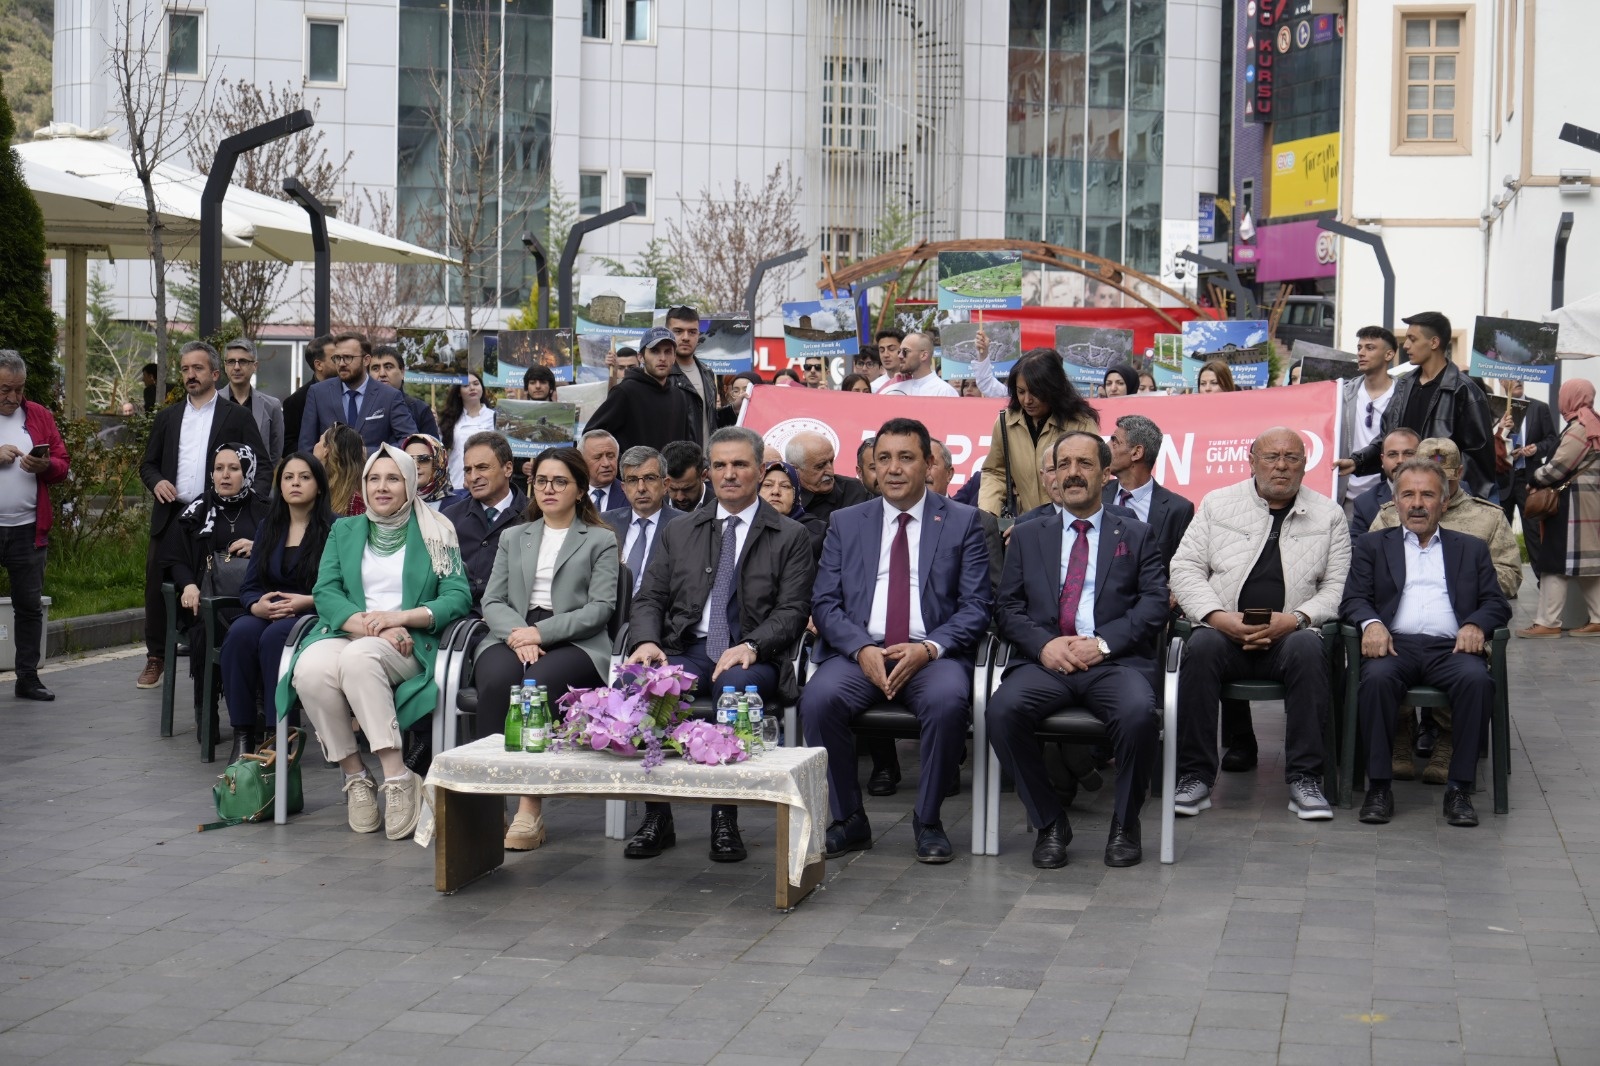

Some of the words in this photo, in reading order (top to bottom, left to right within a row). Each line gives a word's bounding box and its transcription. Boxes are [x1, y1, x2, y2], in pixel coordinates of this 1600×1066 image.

[1257, 39, 1274, 113] KURSU
[1205, 446, 1250, 463] GÜMÜ
[1205, 464, 1245, 475] VALİ
